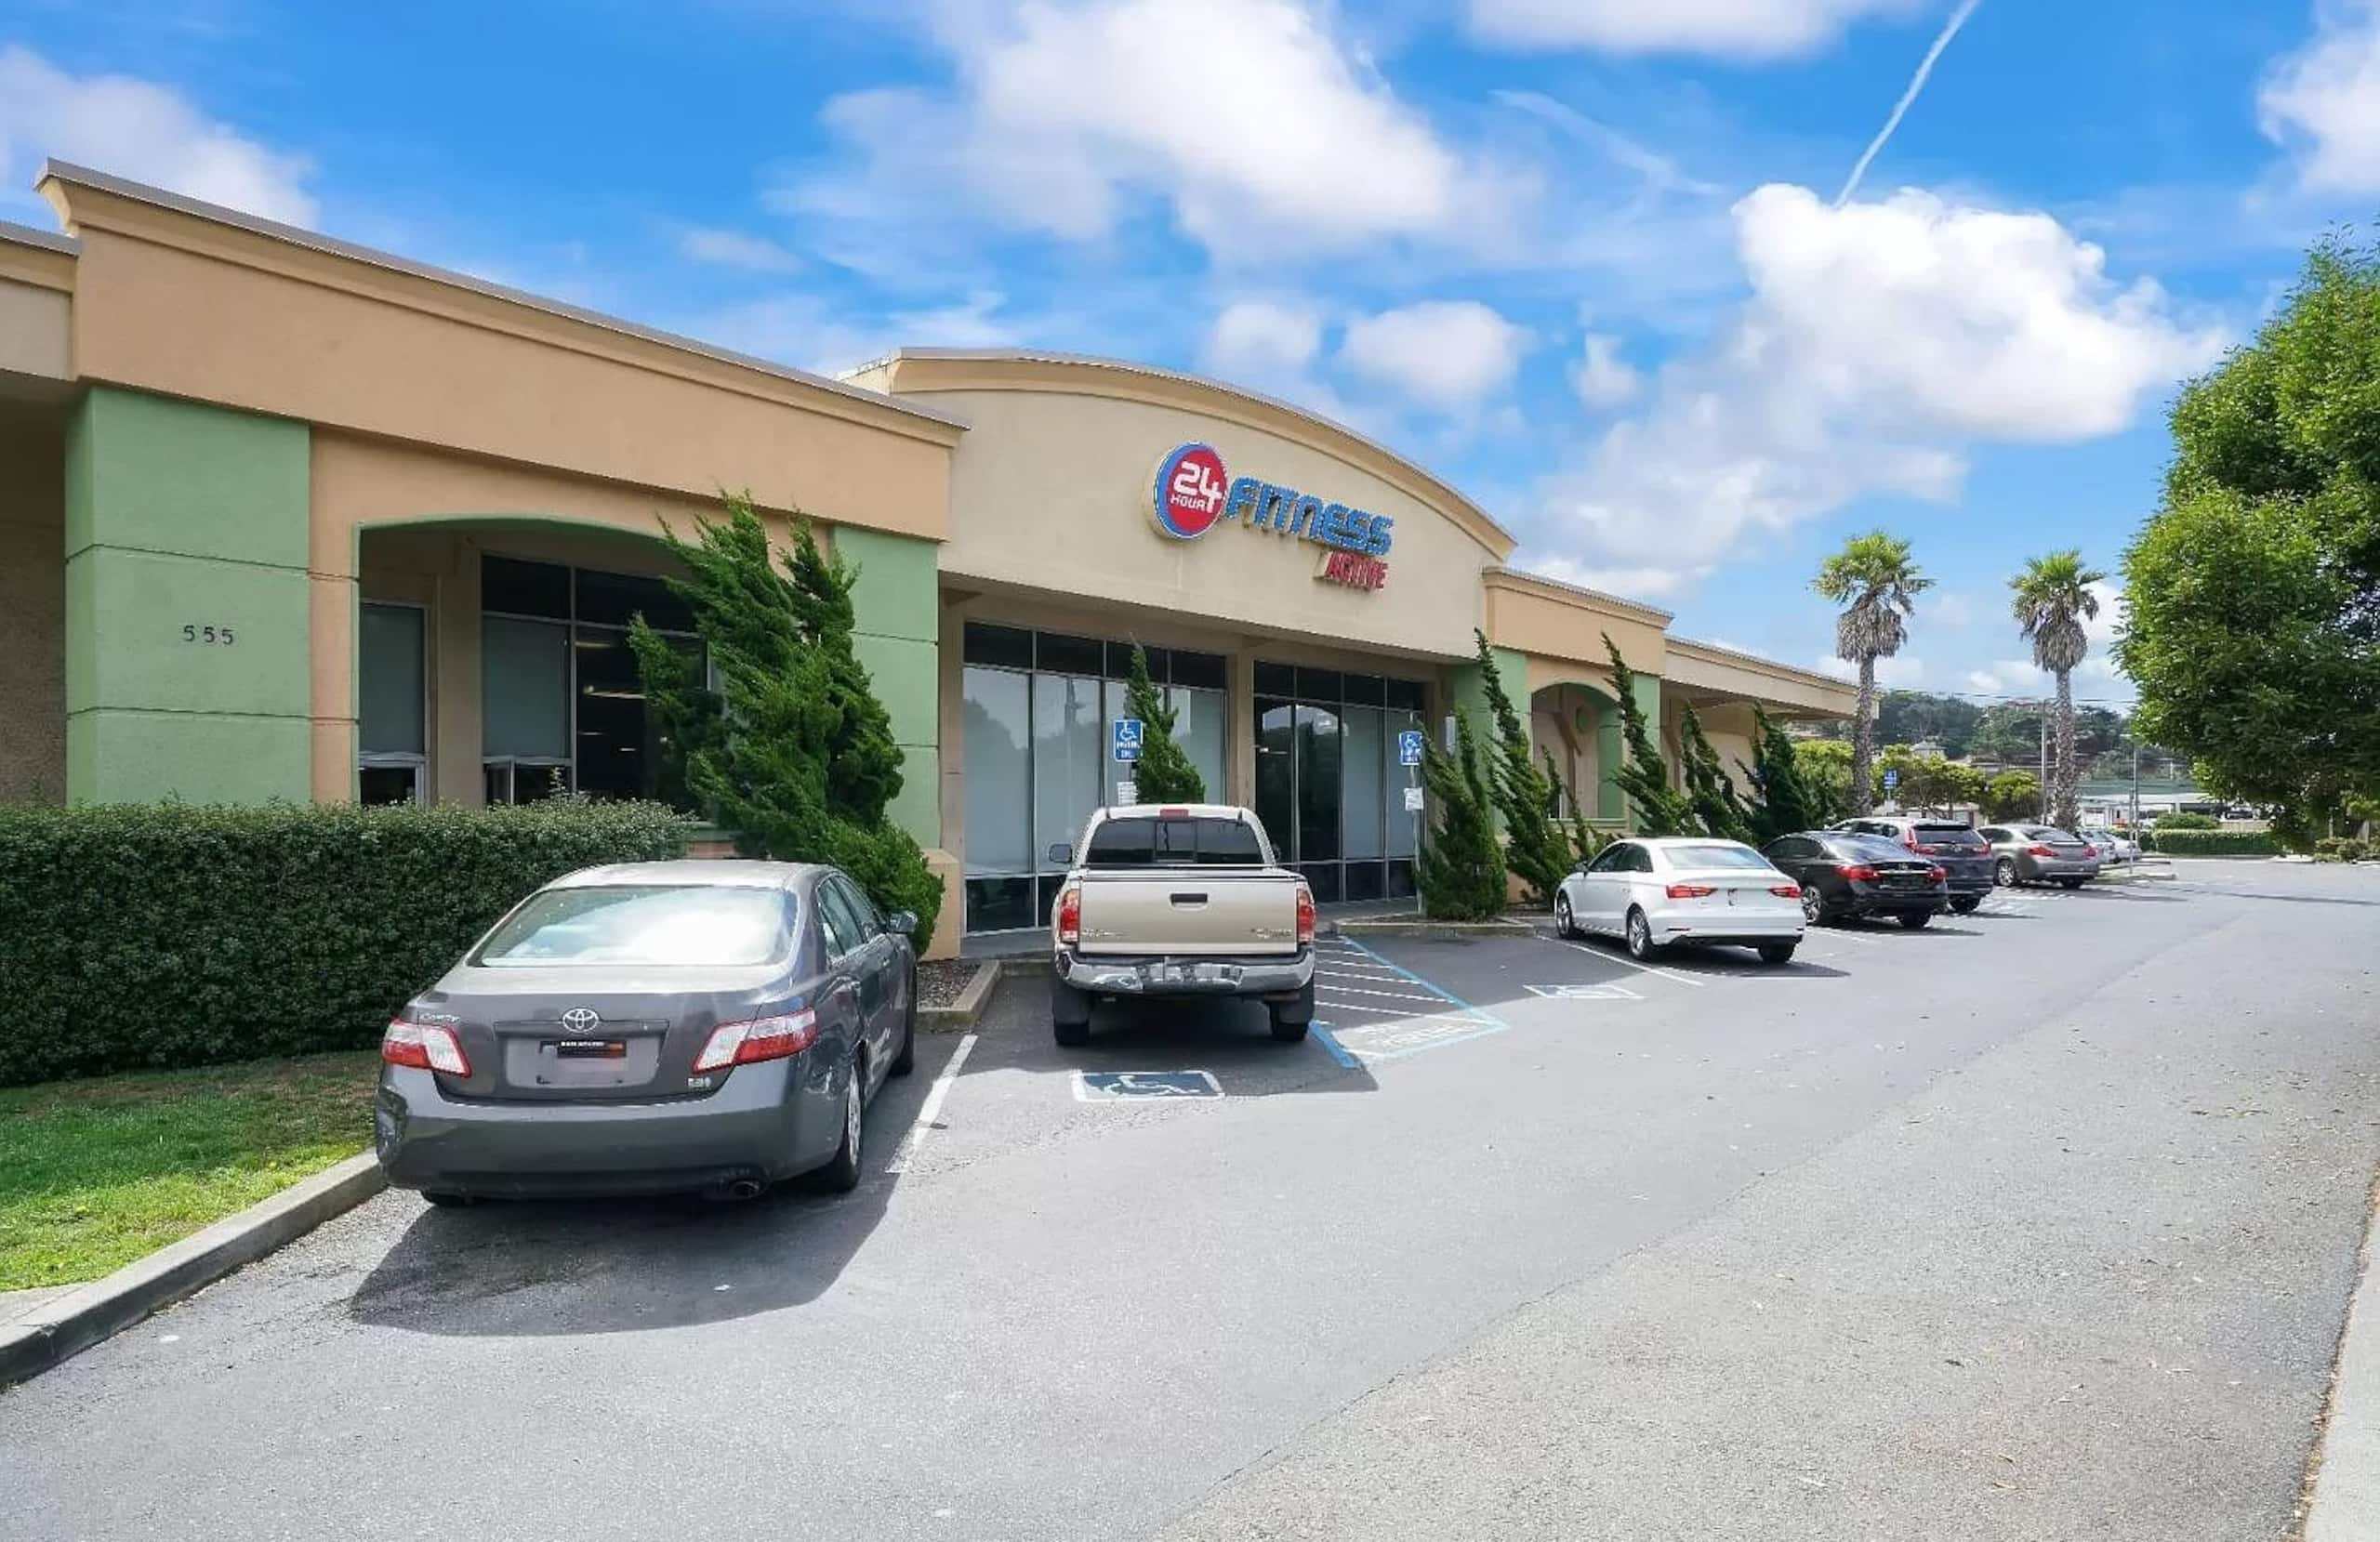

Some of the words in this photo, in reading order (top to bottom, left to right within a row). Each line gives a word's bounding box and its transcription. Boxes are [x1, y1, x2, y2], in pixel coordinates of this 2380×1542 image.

[1170, 494, 1206, 511] HOUR
[1173, 460, 1223, 513] 24
[1224, 475, 1393, 556] FITNESS
[1325, 550, 1389, 589] ACTIVE
[183, 624, 234, 645] 555
